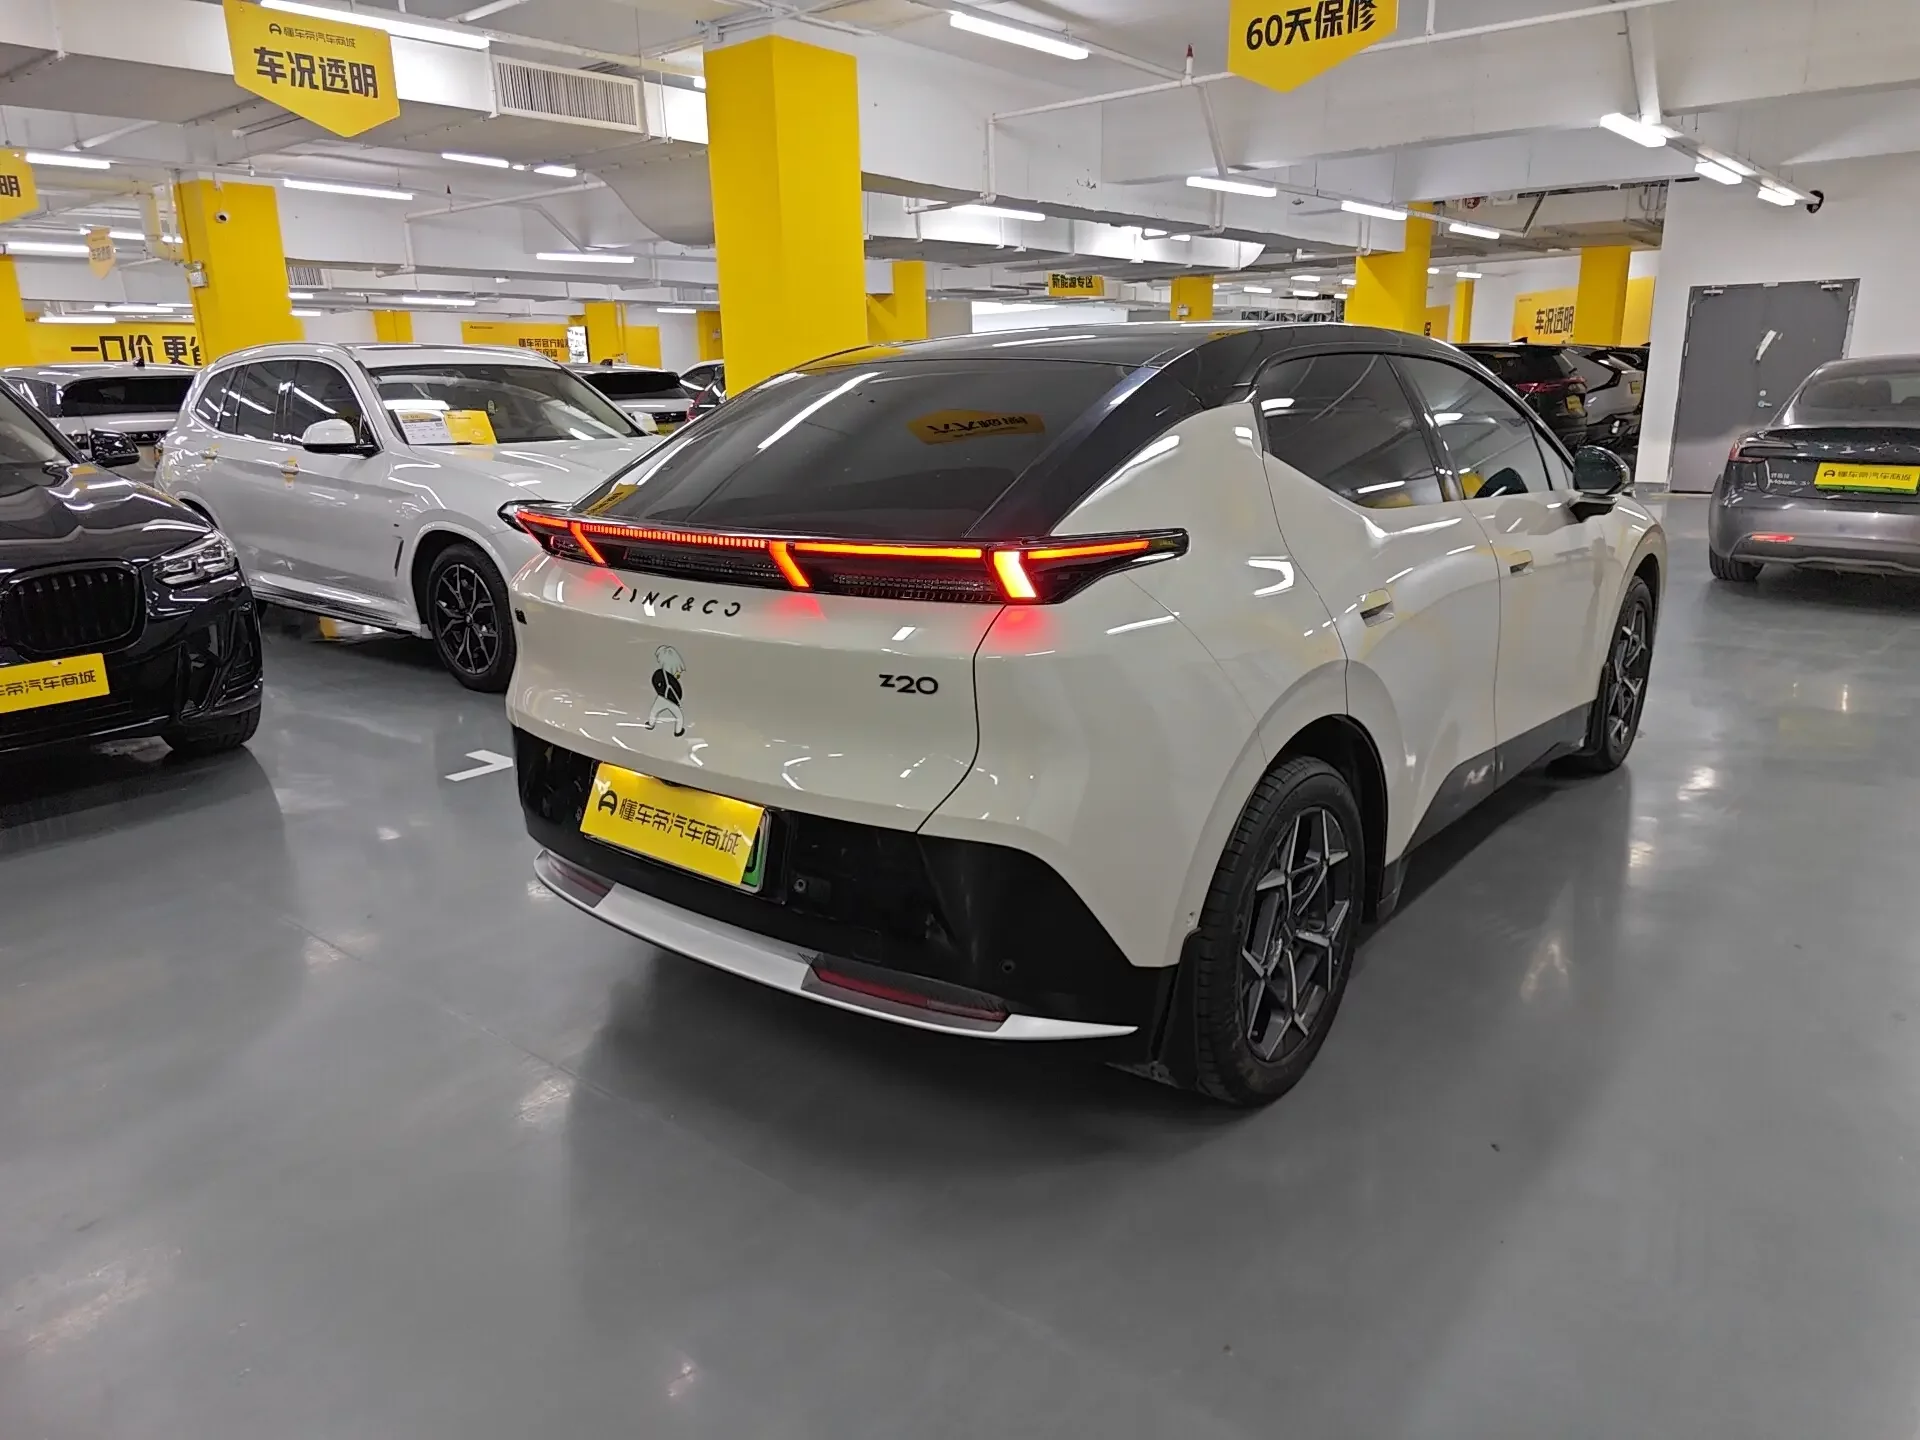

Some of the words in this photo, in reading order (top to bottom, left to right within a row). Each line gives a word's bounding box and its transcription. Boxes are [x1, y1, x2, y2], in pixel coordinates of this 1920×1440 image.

[1246, 0, 1377, 51] 60天保修
[254, 46, 379, 99] 车况透明
[1052, 273, 1094, 289] 新能源专区
[1534, 305, 1575, 335] 车况透明
[878, 674, 939, 695] Z20
[618, 797, 743, 856] 懂车帝汽车商城
